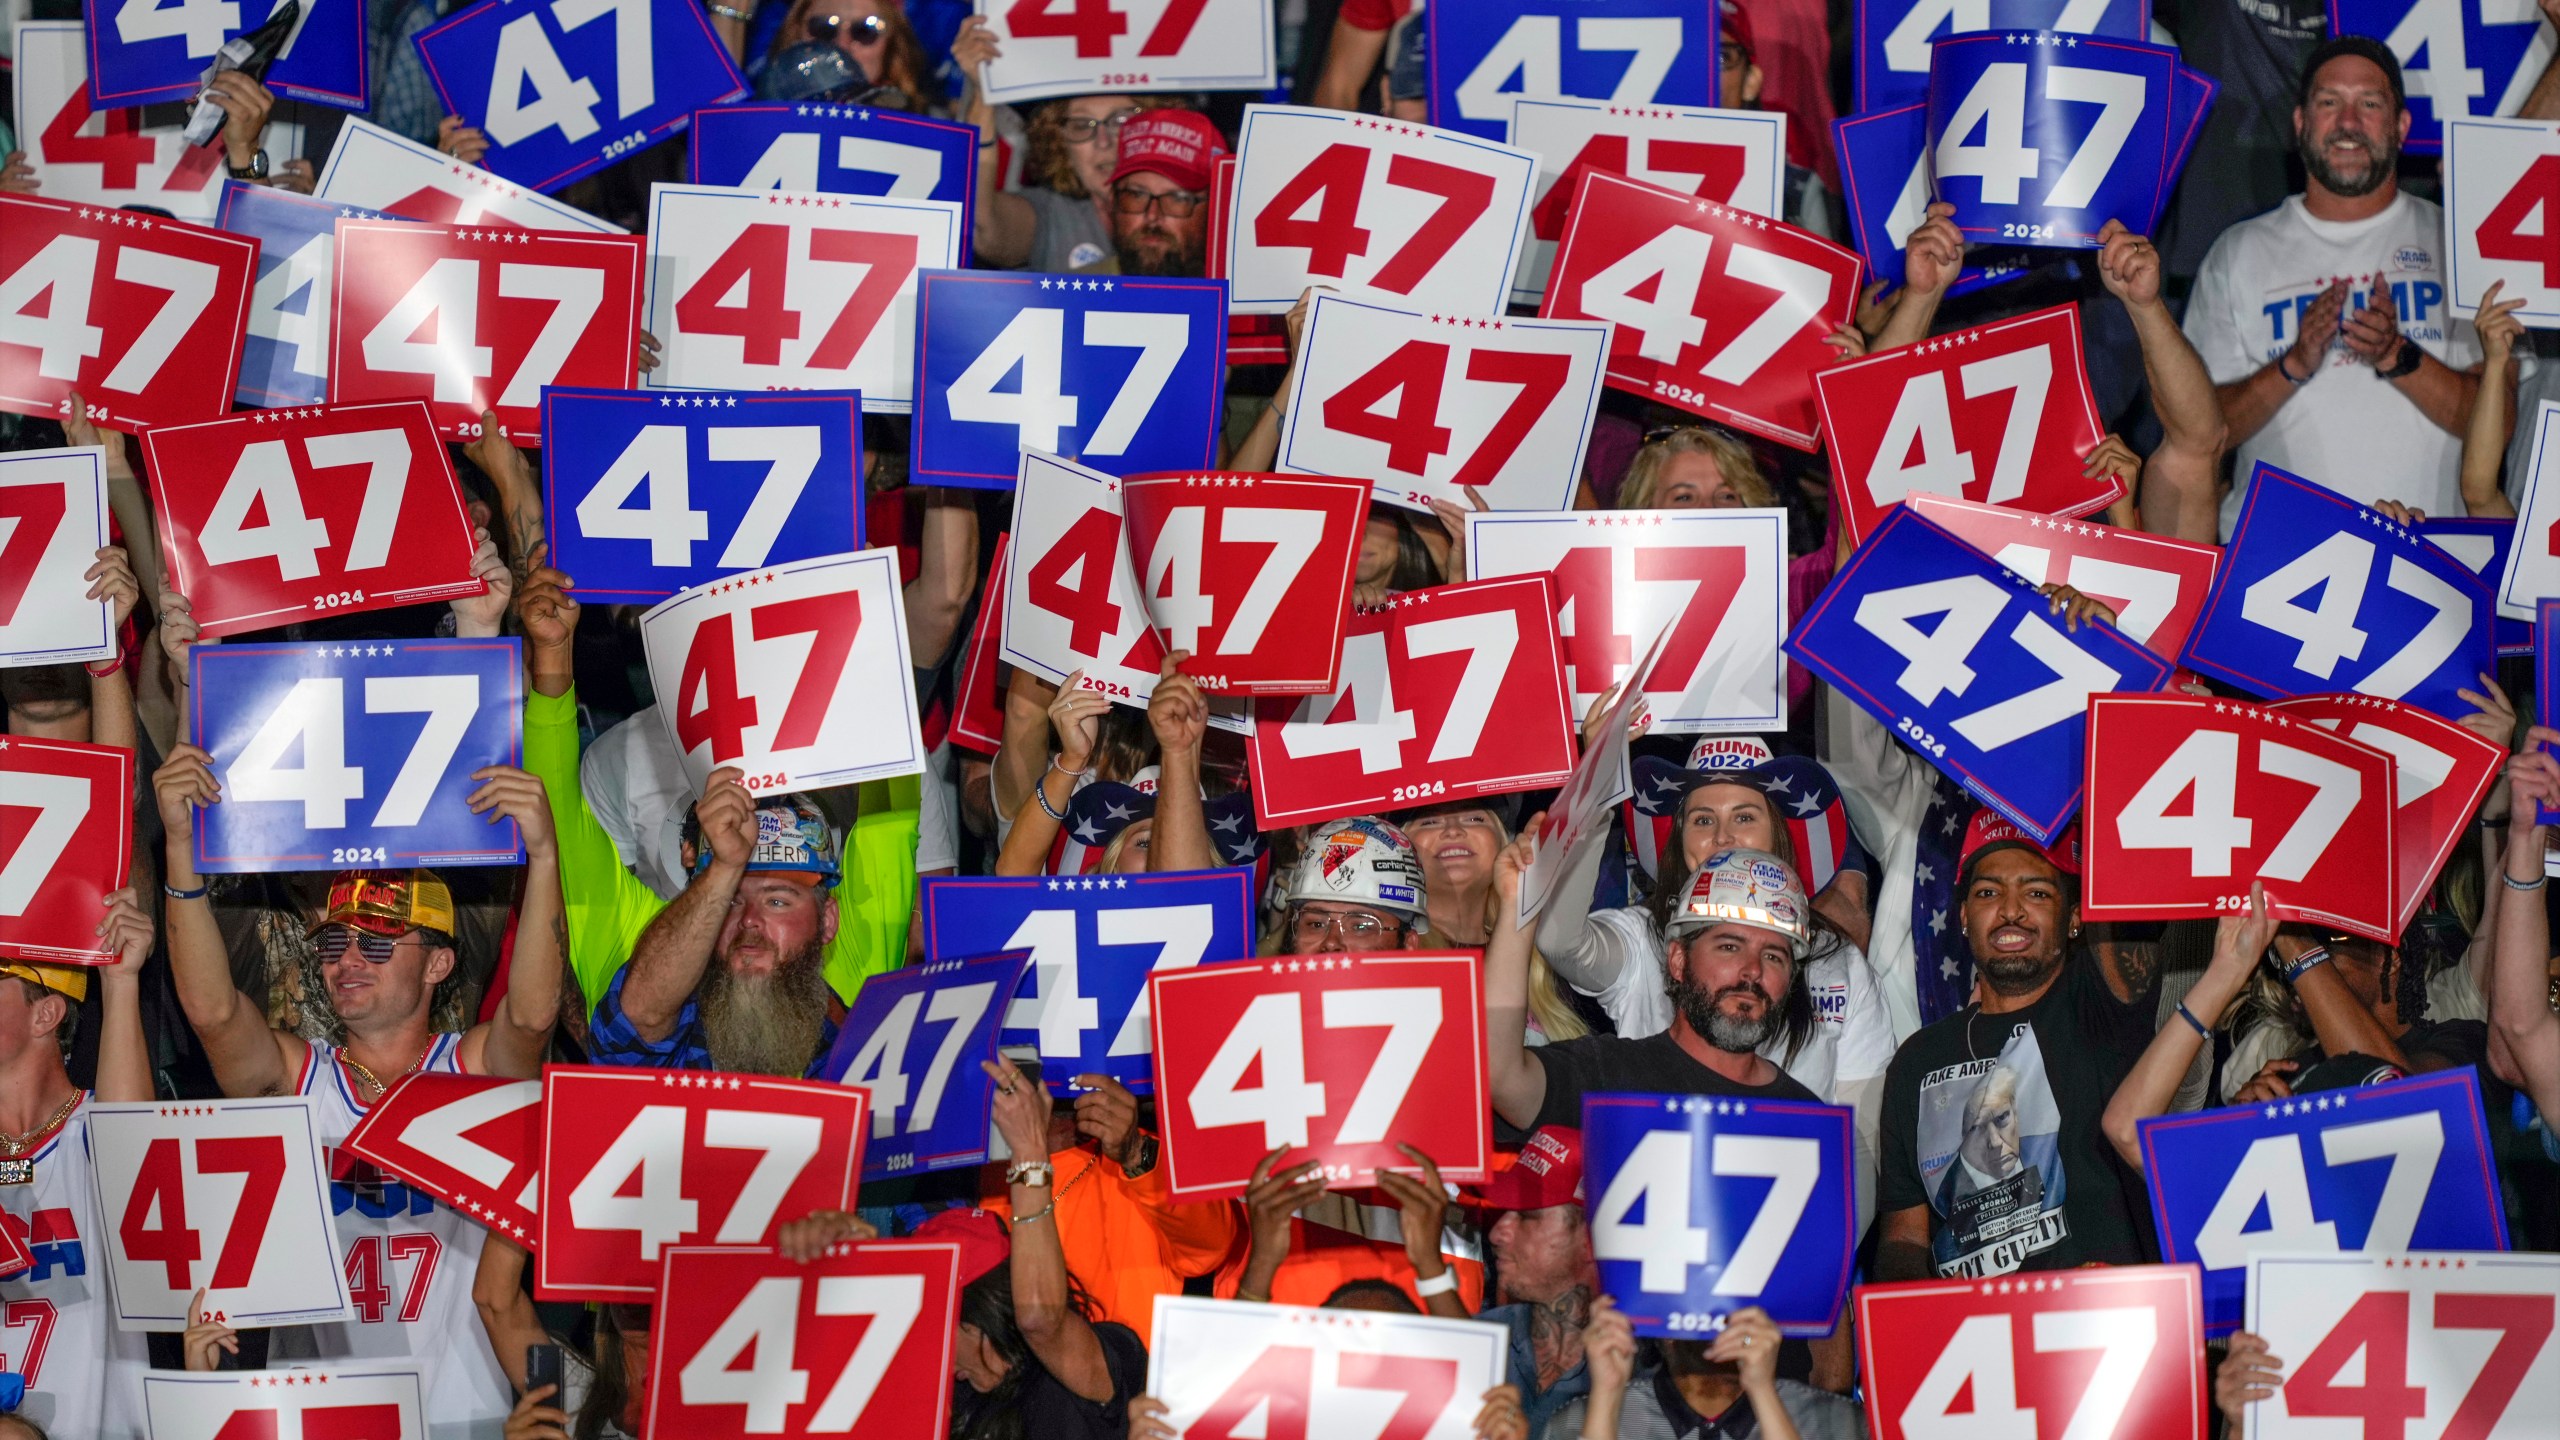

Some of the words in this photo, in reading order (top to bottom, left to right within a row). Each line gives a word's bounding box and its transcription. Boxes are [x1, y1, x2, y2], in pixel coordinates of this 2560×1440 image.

[484, 0, 655, 148] 47
[1102, 73, 1151, 85] 2024
[1456, 14, 1683, 121] 47
[601, 129, 647, 161] 2024
[1152, 122, 1203, 148] AMERICA
[1155, 139, 1197, 163] AGAIN
[1936, 61, 2147, 208] 47
[1254, 143, 1496, 296] 47
[2003, 223, 2055, 239] 2024
[2476, 155, 2560, 290] 4
[0, 234, 220, 396] 47
[675, 223, 919, 371] 47
[1581, 225, 1832, 387] 47
[362, 258, 606, 408] 47
[946, 308, 1190, 457] 47
[1654, 380, 1706, 408] 2024
[59, 400, 108, 421] 224
[458, 422, 508, 438] 204
[1322, 339, 1574, 487] 47
[1866, 343, 2053, 508] 47
[198, 427, 413, 582] 47
[576, 425, 821, 569] 47
[1407, 491, 1431, 505] 20
[313, 589, 364, 611] 2024
[1146, 505, 1328, 657] 47
[1553, 545, 1747, 694] 47
[2242, 529, 2473, 700] 47
[676, 589, 862, 765] 47
[1191, 674, 1228, 690] 2024
[1854, 574, 2122, 753] 47
[1083, 675, 1131, 699] 2024
[1280, 608, 1520, 776] 47
[226, 674, 480, 830] 47
[1692, 740, 1767, 762] TRUMP
[1898, 716, 1947, 759] 2024
[1697, 754, 1755, 772] 2024
[1393, 780, 1446, 801] 2024
[2115, 728, 2362, 882] 47
[757, 815, 779, 826] EAM
[759, 823, 781, 834] UMP
[332, 847, 387, 864] 2024
[1752, 868, 1787, 882] TRUMP
[1756, 863, 1784, 875] TEAM
[357, 884, 397, 907] AGAIN
[1380, 887, 1394, 896] H.M.
[1395, 889, 1415, 899] WHITE
[1761, 880, 1779, 889] 2024
[2215, 895, 2268, 911] 202
[998, 904, 1213, 1058] 47
[2301, 960, 2313, 971] Hal
[838, 981, 998, 1138] 47
[1188, 987, 1444, 1150] 47
[1923, 1066, 1955, 1088] TAKE
[569, 1105, 823, 1260] 47
[886, 1152, 914, 1171] 2024
[1295, 1164, 1352, 1184] 024
[119, 1135, 287, 1290] 47
[1957, 1198, 1983, 1212] POLICE
[1979, 1195, 2014, 1212] GEORGIA
[2194, 1110, 2446, 1272] 47
[1593, 1130, 1821, 1297] 47
[1980, 1219, 2006, 1234] ELECTION
[1986, 1226, 2007, 1237] NEVER
[1941, 1253, 1985, 1280] NOT
[1993, 1212, 2063, 1269] GULTY
[343, 1232, 443, 1323] 47
[200, 1310, 226, 1323] 24
[1667, 1311, 1727, 1332] 2024
[679, 1274, 924, 1434] 47
[1899, 1305, 2158, 1440] 47
[2284, 1290, 2557, 1440] 47
